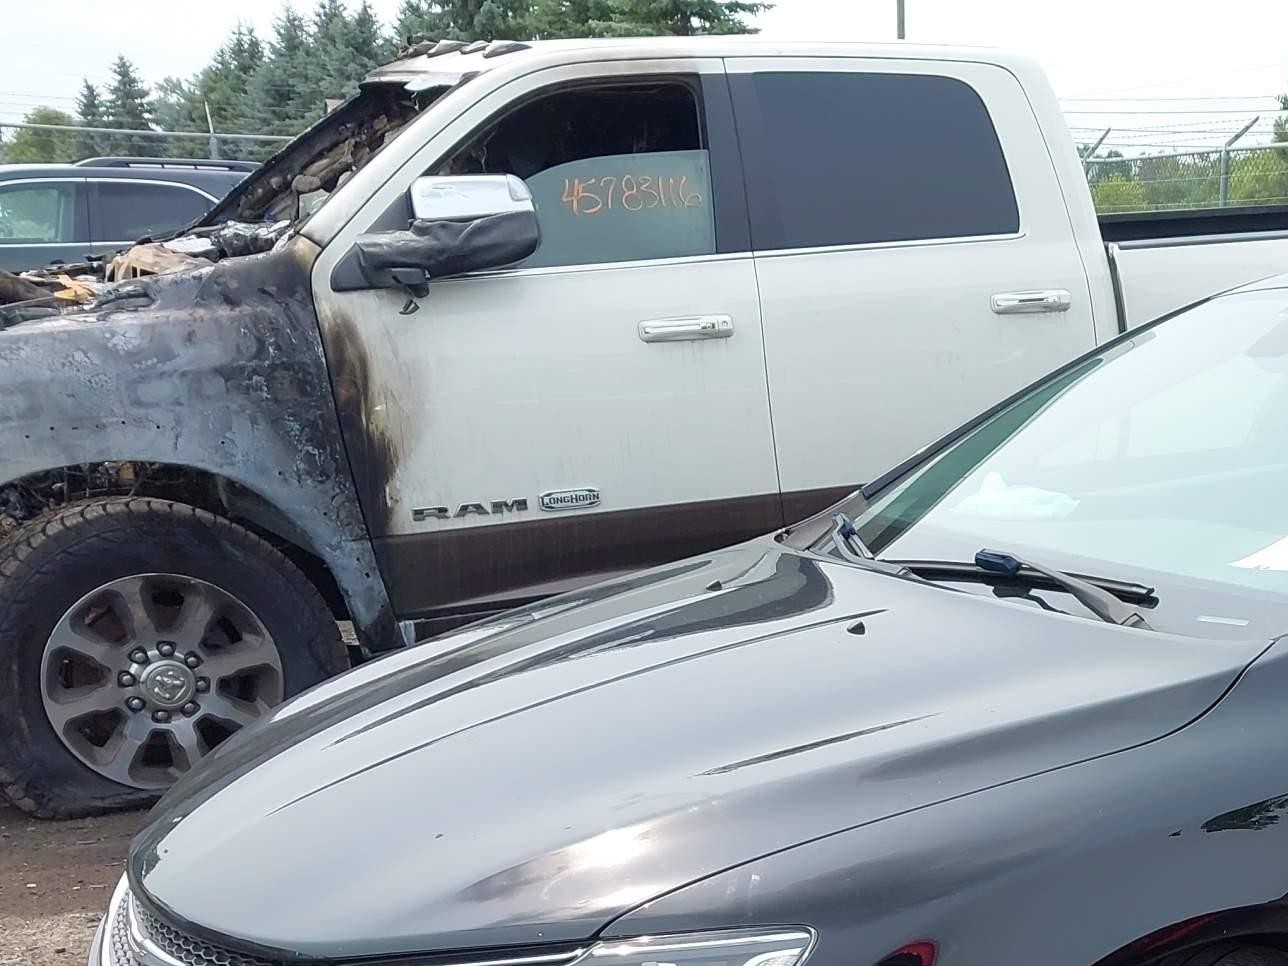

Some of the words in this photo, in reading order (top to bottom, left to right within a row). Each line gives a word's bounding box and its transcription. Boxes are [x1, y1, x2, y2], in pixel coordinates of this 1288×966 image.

[561, 174, 703, 215] 45783116
[411, 497, 529, 522] RAM
[540, 490, 600, 509] LONGHORN
